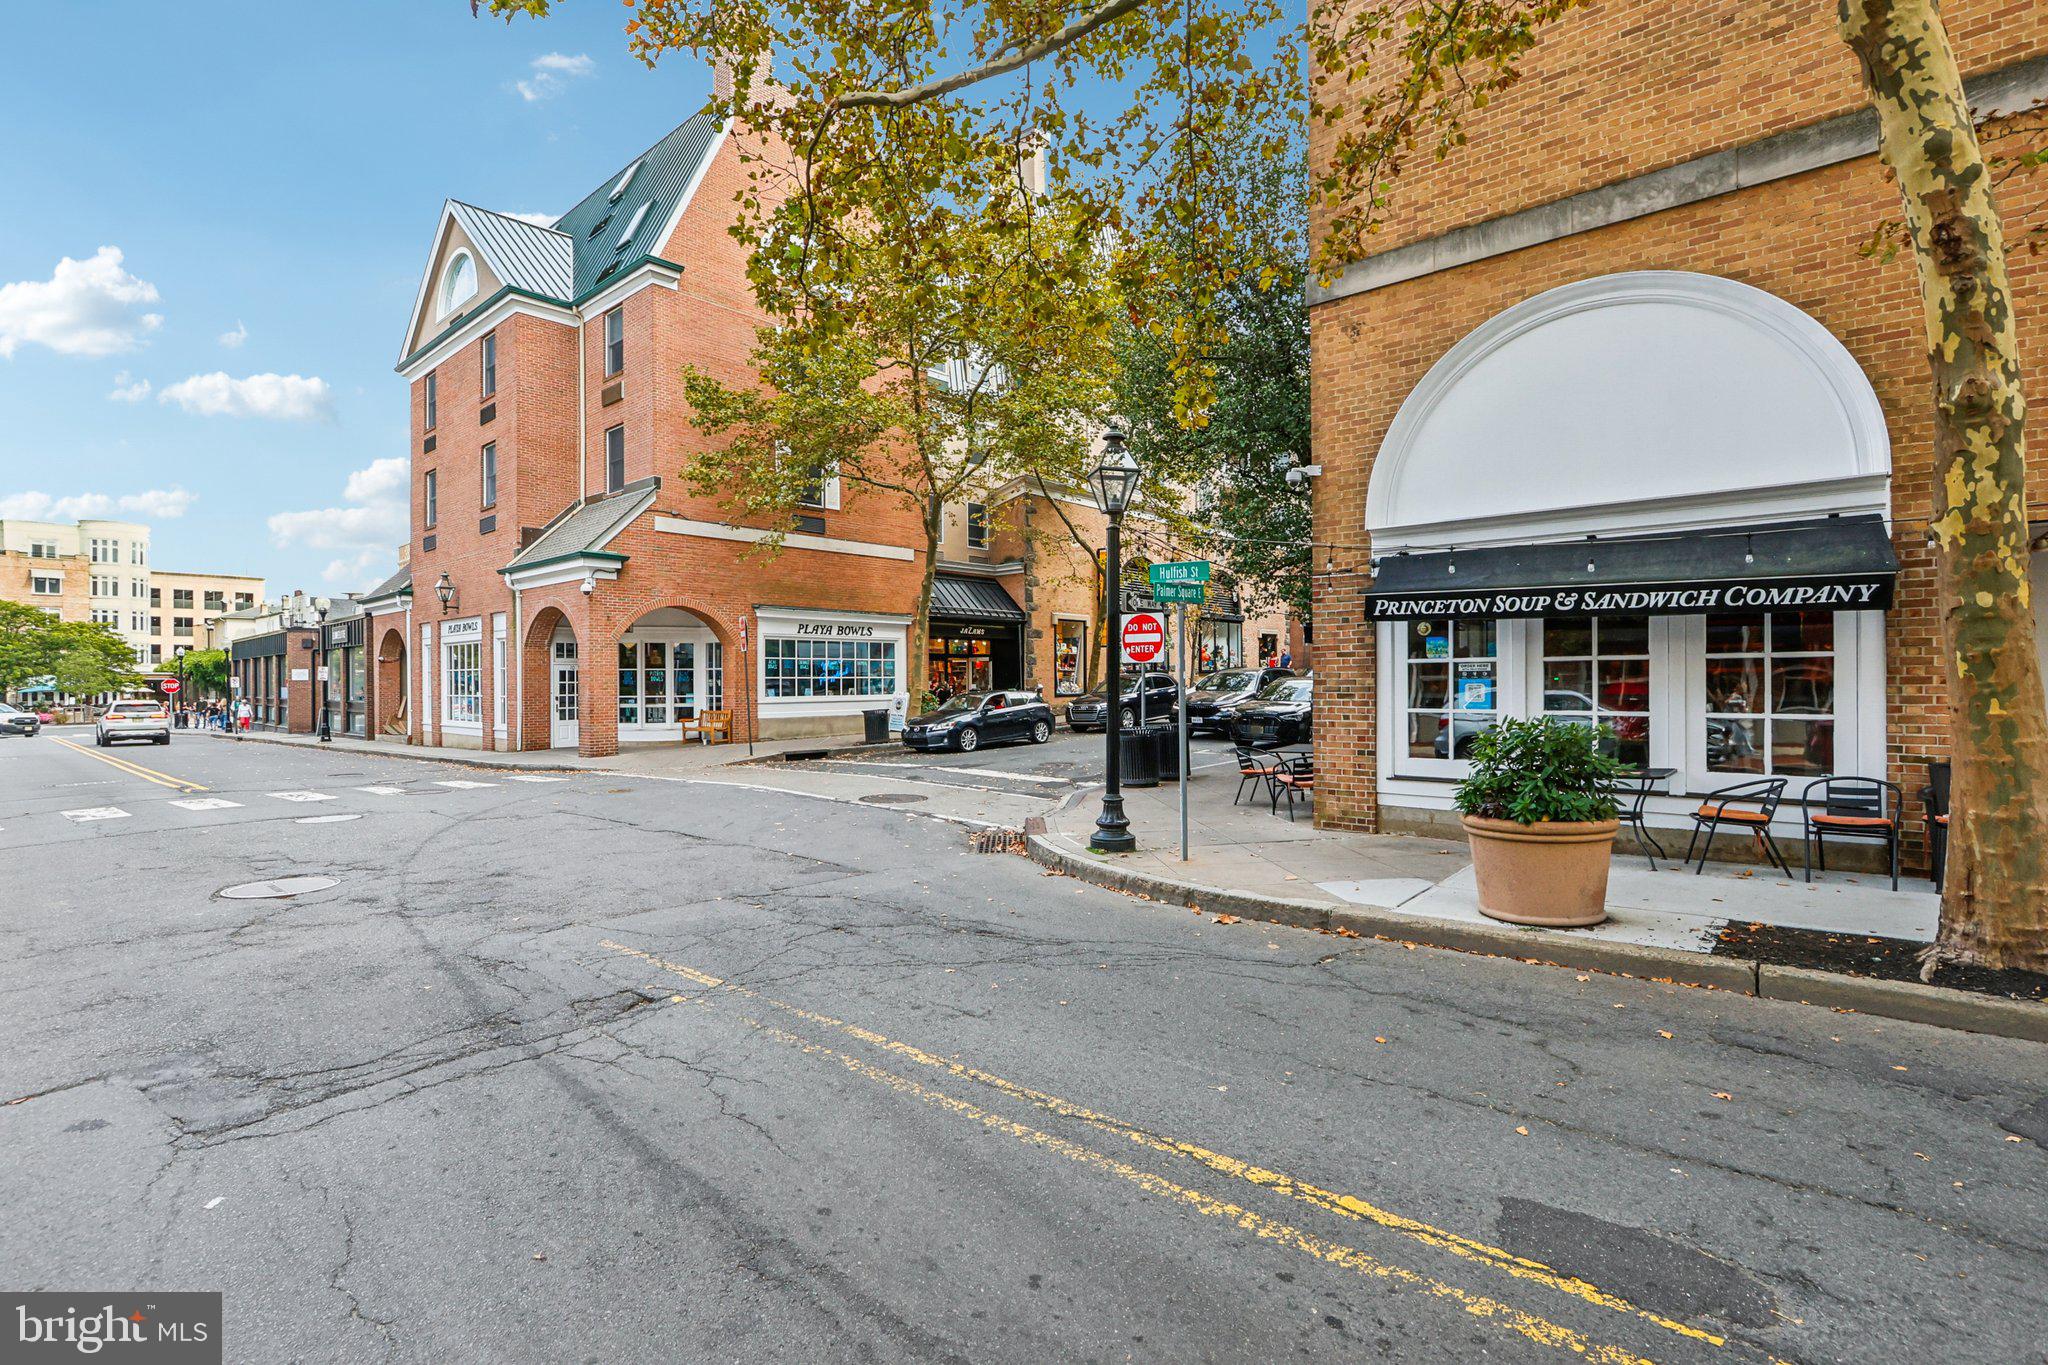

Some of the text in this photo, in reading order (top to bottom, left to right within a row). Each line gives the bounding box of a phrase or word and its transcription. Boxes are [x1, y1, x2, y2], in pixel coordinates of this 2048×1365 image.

[1160, 566, 1199, 579] Hulfish St
[1156, 584, 1201, 601] Palmer Square E
[1373, 583, 1881, 616] PRINCETON SOUP & SANDWICH COMPANY
[447, 621, 478, 634] PLAYA BOWLS
[797, 623, 874, 636] PLAYA BOWLS
[1127, 622, 1157, 631] DO NOT
[1130, 645, 1155, 653] ENTER
[163, 682, 180, 690] STOP
